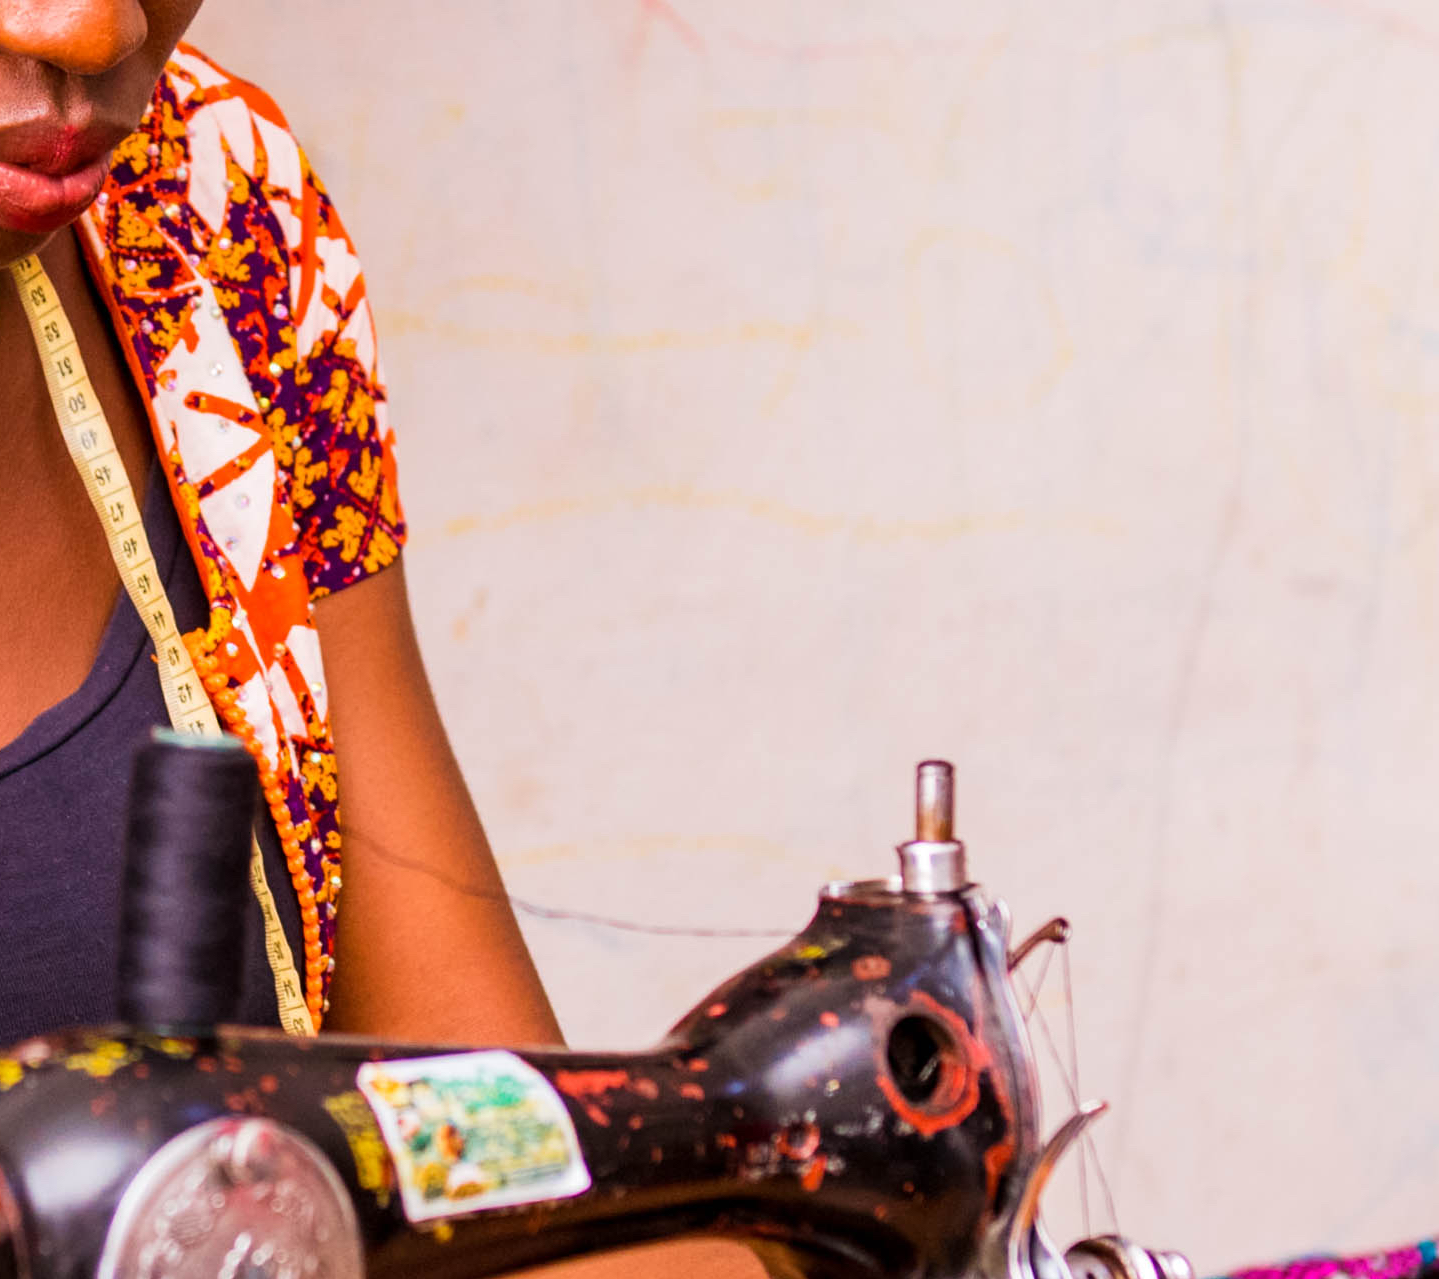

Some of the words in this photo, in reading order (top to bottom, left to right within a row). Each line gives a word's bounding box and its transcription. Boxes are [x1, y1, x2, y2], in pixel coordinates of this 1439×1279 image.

[31, 285, 47, 306] 53
[44, 321, 61, 342] 52
[57, 356, 73, 377] 51
[69, 392, 87, 413] 50
[81, 428, 98, 450] 49
[94, 465, 112, 486] 48
[110, 501, 124, 523] 47
[123, 537, 137, 558] 46
[137, 573, 151, 594] 45
[167, 646, 180, 666] 43
[178, 682, 193, 703] 42
